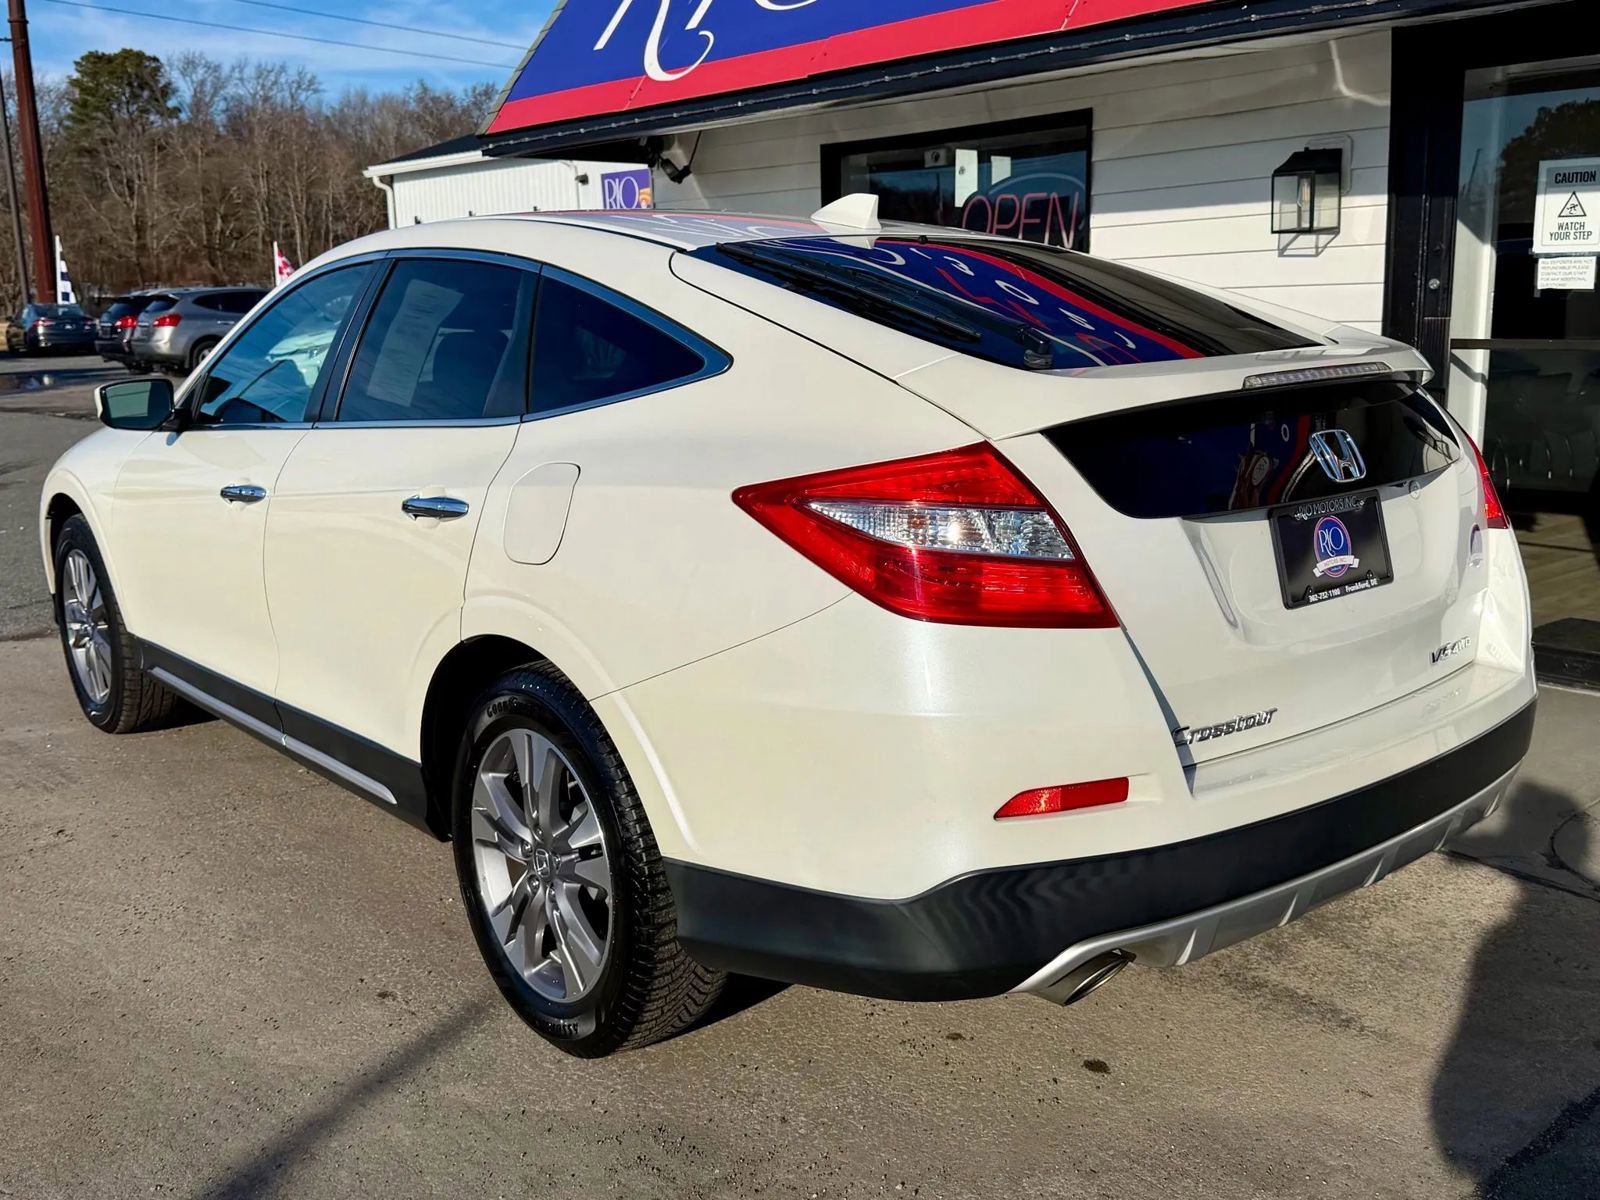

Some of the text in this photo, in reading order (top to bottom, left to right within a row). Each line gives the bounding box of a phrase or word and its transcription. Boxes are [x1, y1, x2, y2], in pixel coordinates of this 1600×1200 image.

[1554, 170, 1597, 184] CAUTION
[604, 176, 639, 209] RIO
[961, 191, 1080, 250] OPEN
[1557, 221, 1586, 231] WATCH
[1549, 230, 1593, 241] YOUR STEP
[1313, 498, 1344, 515] MOTORS
[1318, 526, 1344, 557] RIO
[1370, 577, 1378, 586] DE
[1171, 707, 1278, 746] Crosstour
